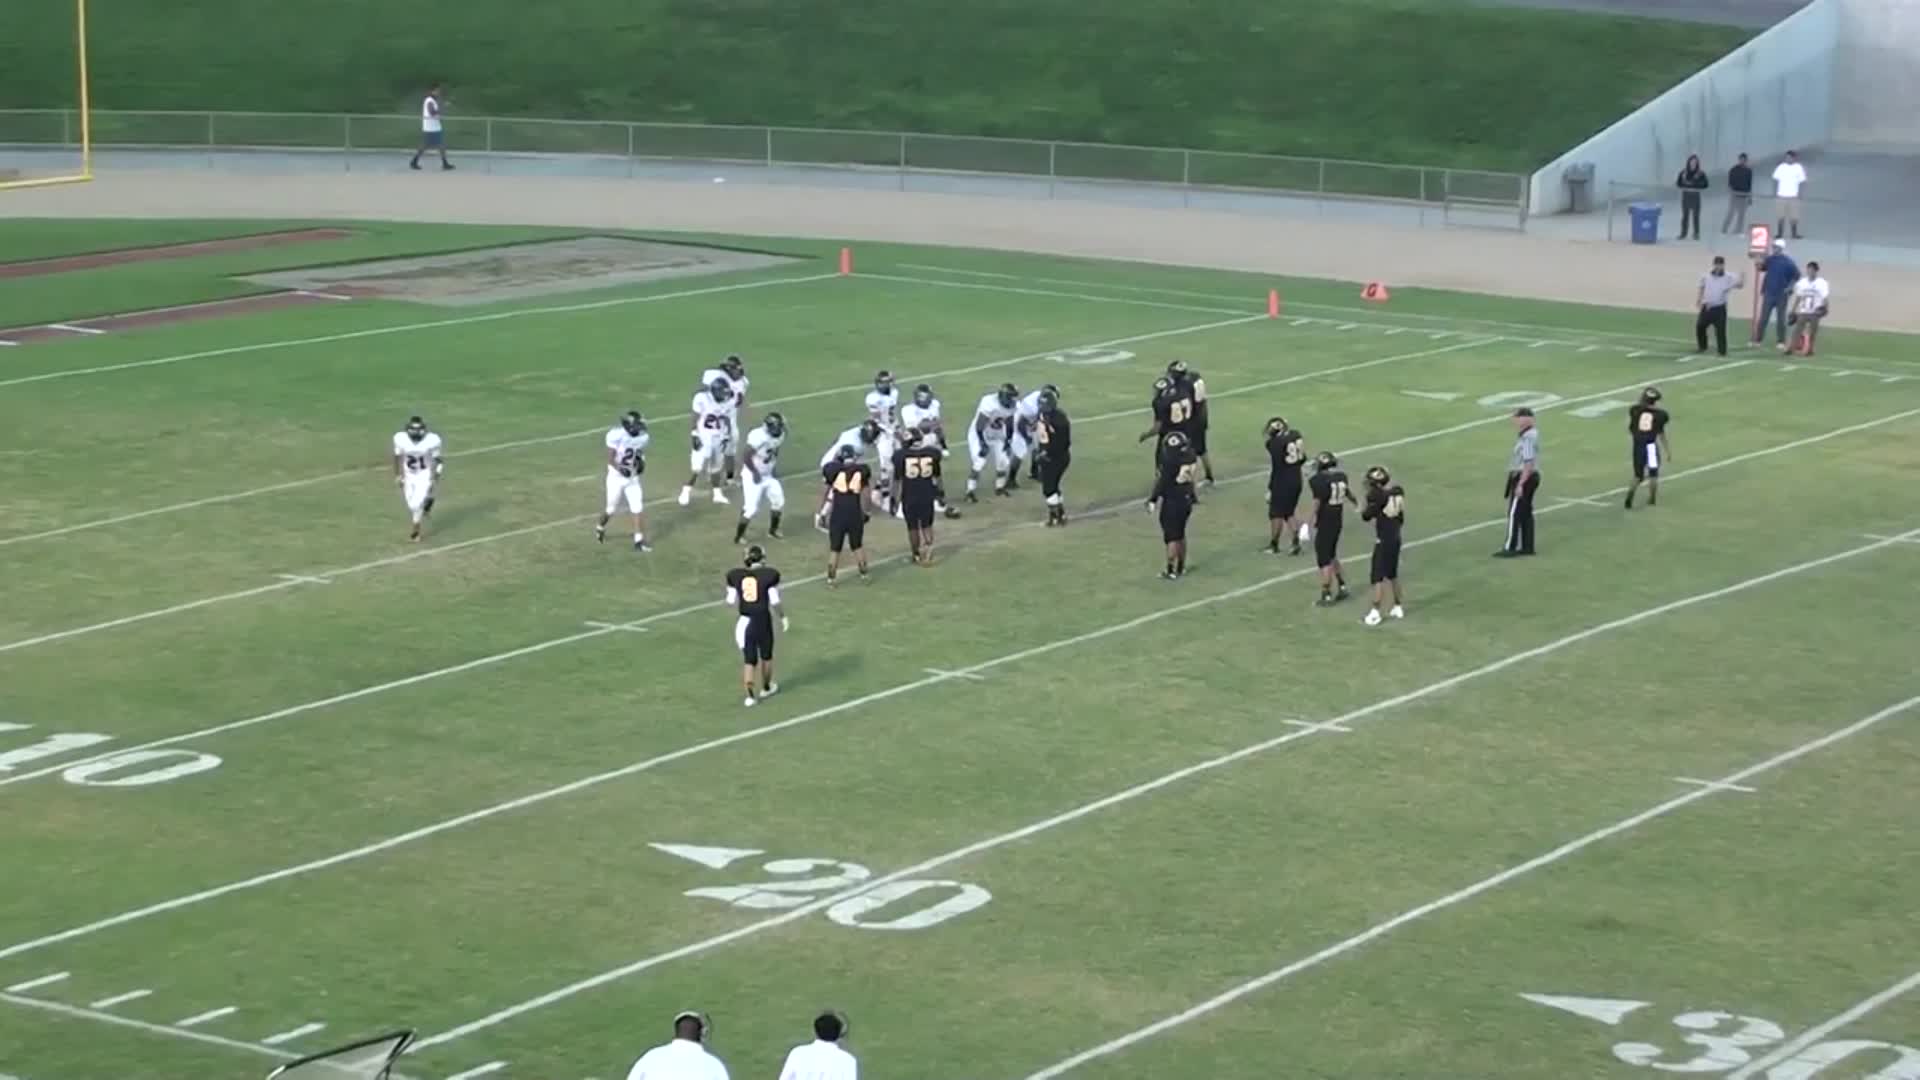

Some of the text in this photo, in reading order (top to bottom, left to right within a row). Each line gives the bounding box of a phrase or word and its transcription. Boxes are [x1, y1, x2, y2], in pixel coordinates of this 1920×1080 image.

[407, 455, 427, 470] 21
[833, 471, 862, 493] 44
[0, 733, 223, 786] 10
[683, 858, 992, 930] 20
